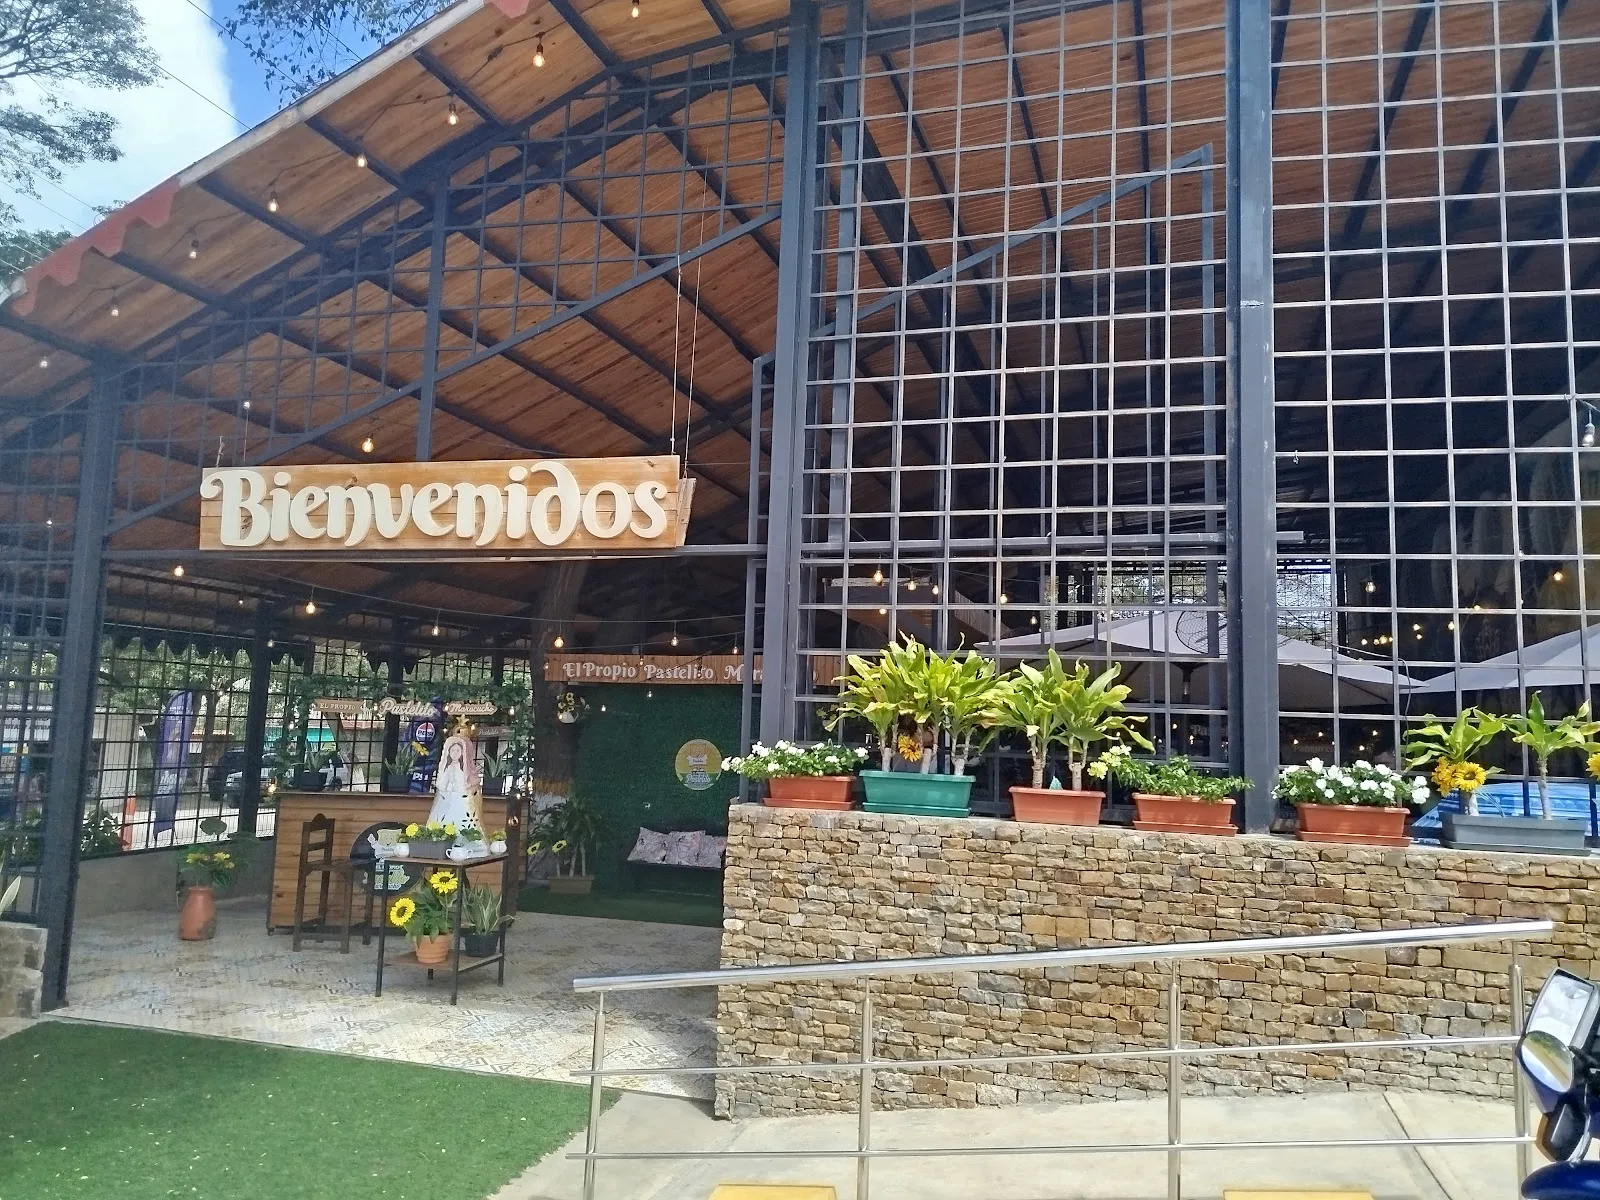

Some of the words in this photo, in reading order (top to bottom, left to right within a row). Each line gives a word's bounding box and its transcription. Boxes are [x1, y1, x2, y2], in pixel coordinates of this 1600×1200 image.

[200, 461, 668, 547] Bienvenidos
[563, 662, 581, 678] El
[583, 662, 636, 681] Propio
[643, 664, 714, 681] Pastelito
[380, 697, 436, 717] Pastelito
[448, 702, 496, 714] Maracucho
